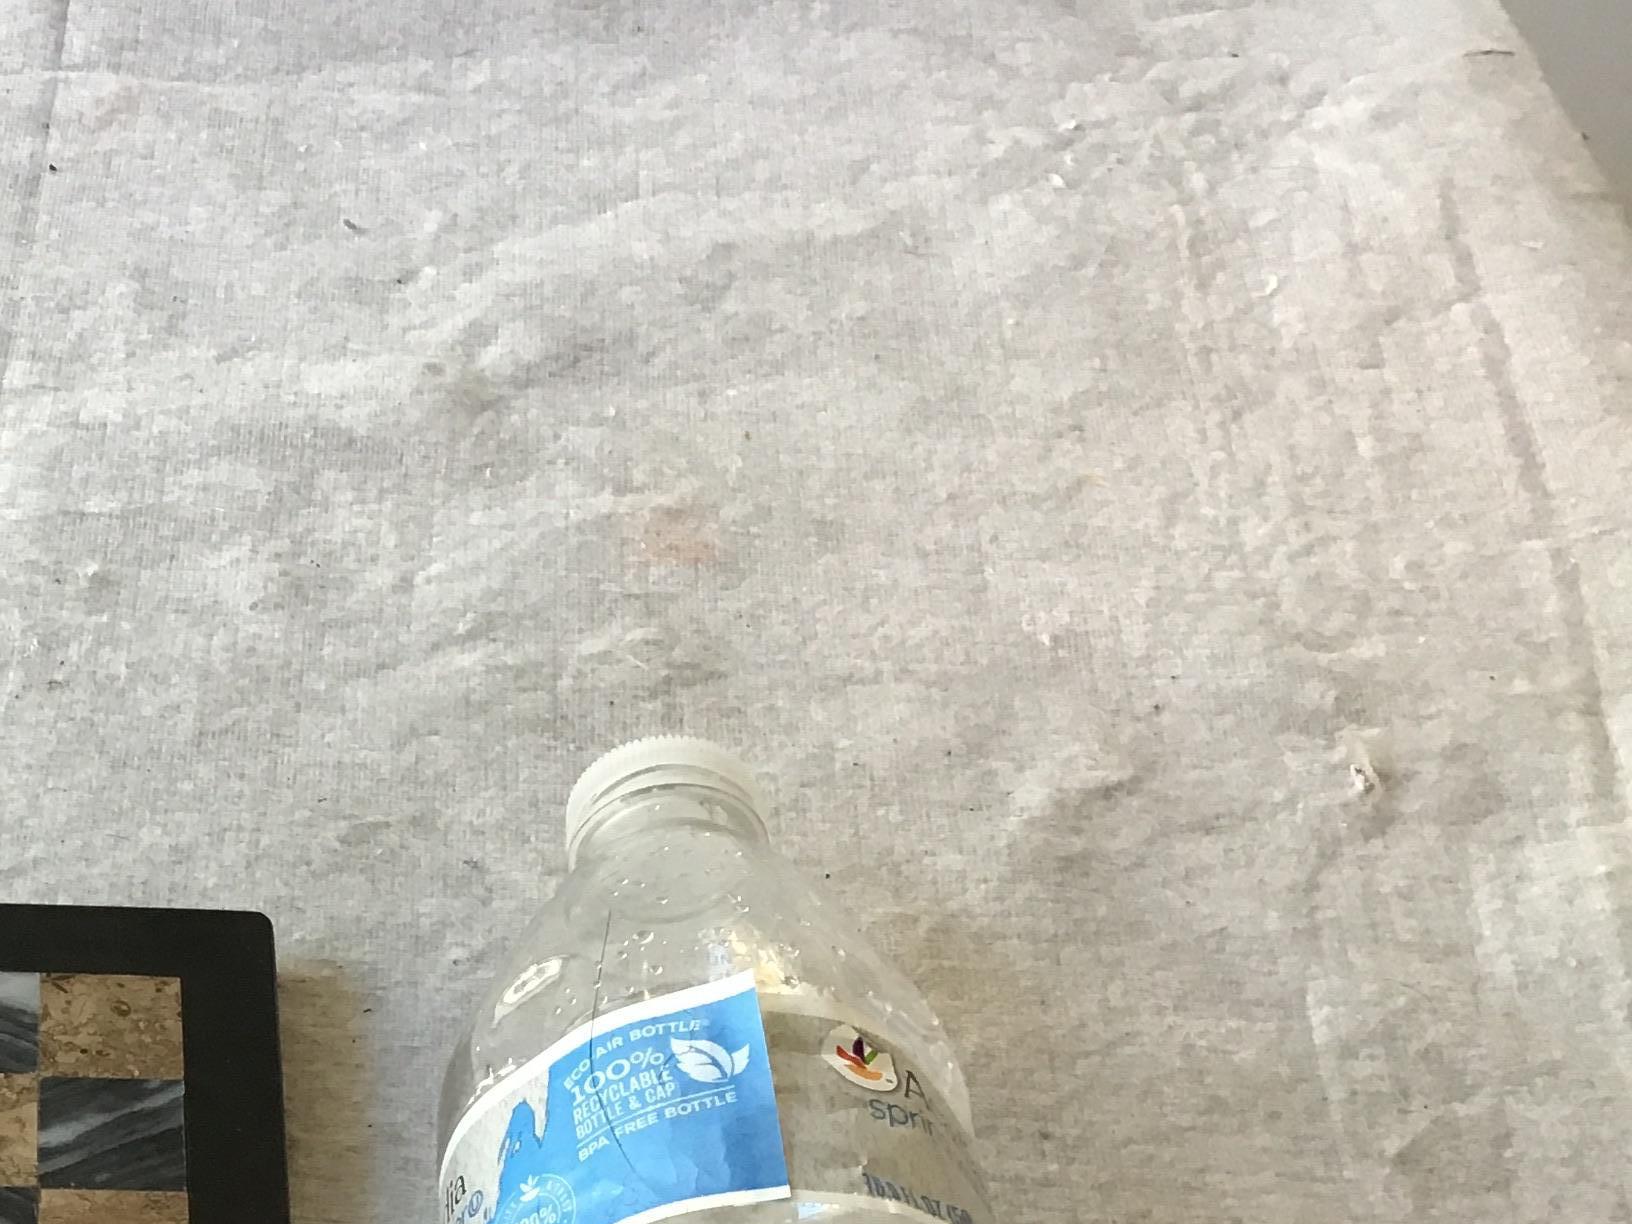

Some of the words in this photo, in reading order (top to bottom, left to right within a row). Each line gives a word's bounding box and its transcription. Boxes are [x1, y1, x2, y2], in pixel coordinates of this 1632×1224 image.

[563, 1058, 591, 1090] ECO
[595, 1036, 624, 1059] AIR
[629, 1019, 702, 1041] BOTTLE
[570, 1046, 665, 1102] 100%
[572, 1063, 674, 1126] RECYCLABLE
[575, 1103, 624, 1140] BOTTLE
[628, 1094, 642, 1111] &
[645, 1081, 676, 1103] CAP
[578, 1135, 610, 1162] BPA
[614, 1111, 660, 1137] FREE
[664, 1091, 739, 1119] BOTTLE
